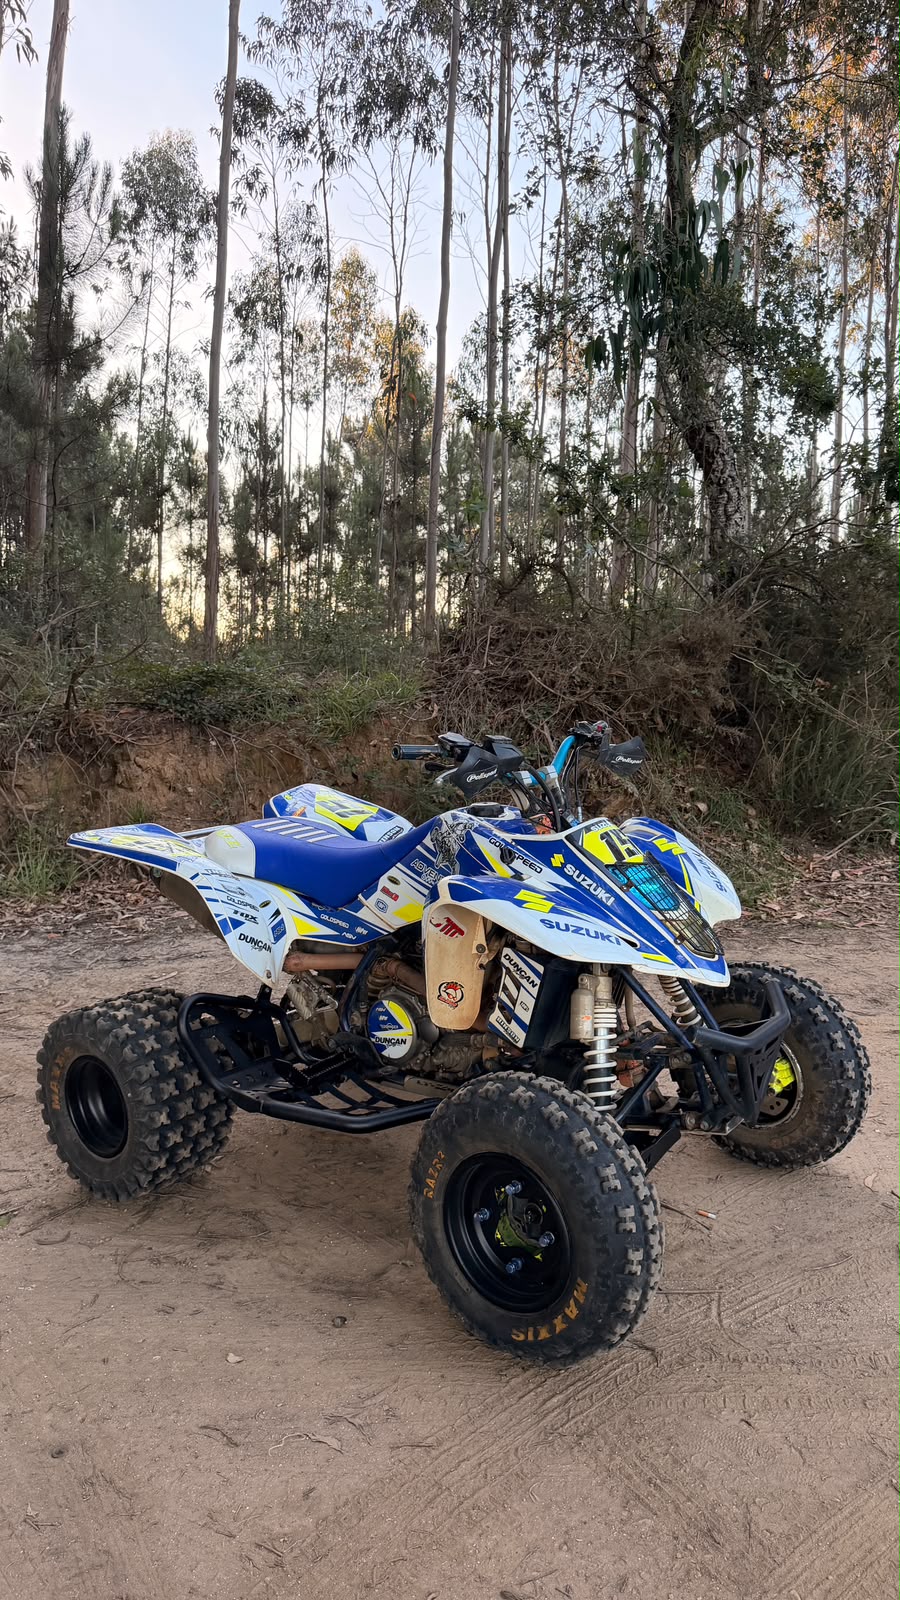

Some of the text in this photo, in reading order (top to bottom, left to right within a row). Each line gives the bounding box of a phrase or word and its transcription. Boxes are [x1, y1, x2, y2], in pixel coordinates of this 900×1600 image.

[489, 837, 543, 874] GOLSPEED
[563, 863, 615, 906] SUZUKI
[238, 932, 272, 954] DUNCAN
[539, 918, 621, 946] SUZUKI
[503, 953, 538, 989] DUNCAN
[375, 1036, 407, 1046] DUNCAN
[511, 1277, 588, 1343] MAXXIS
